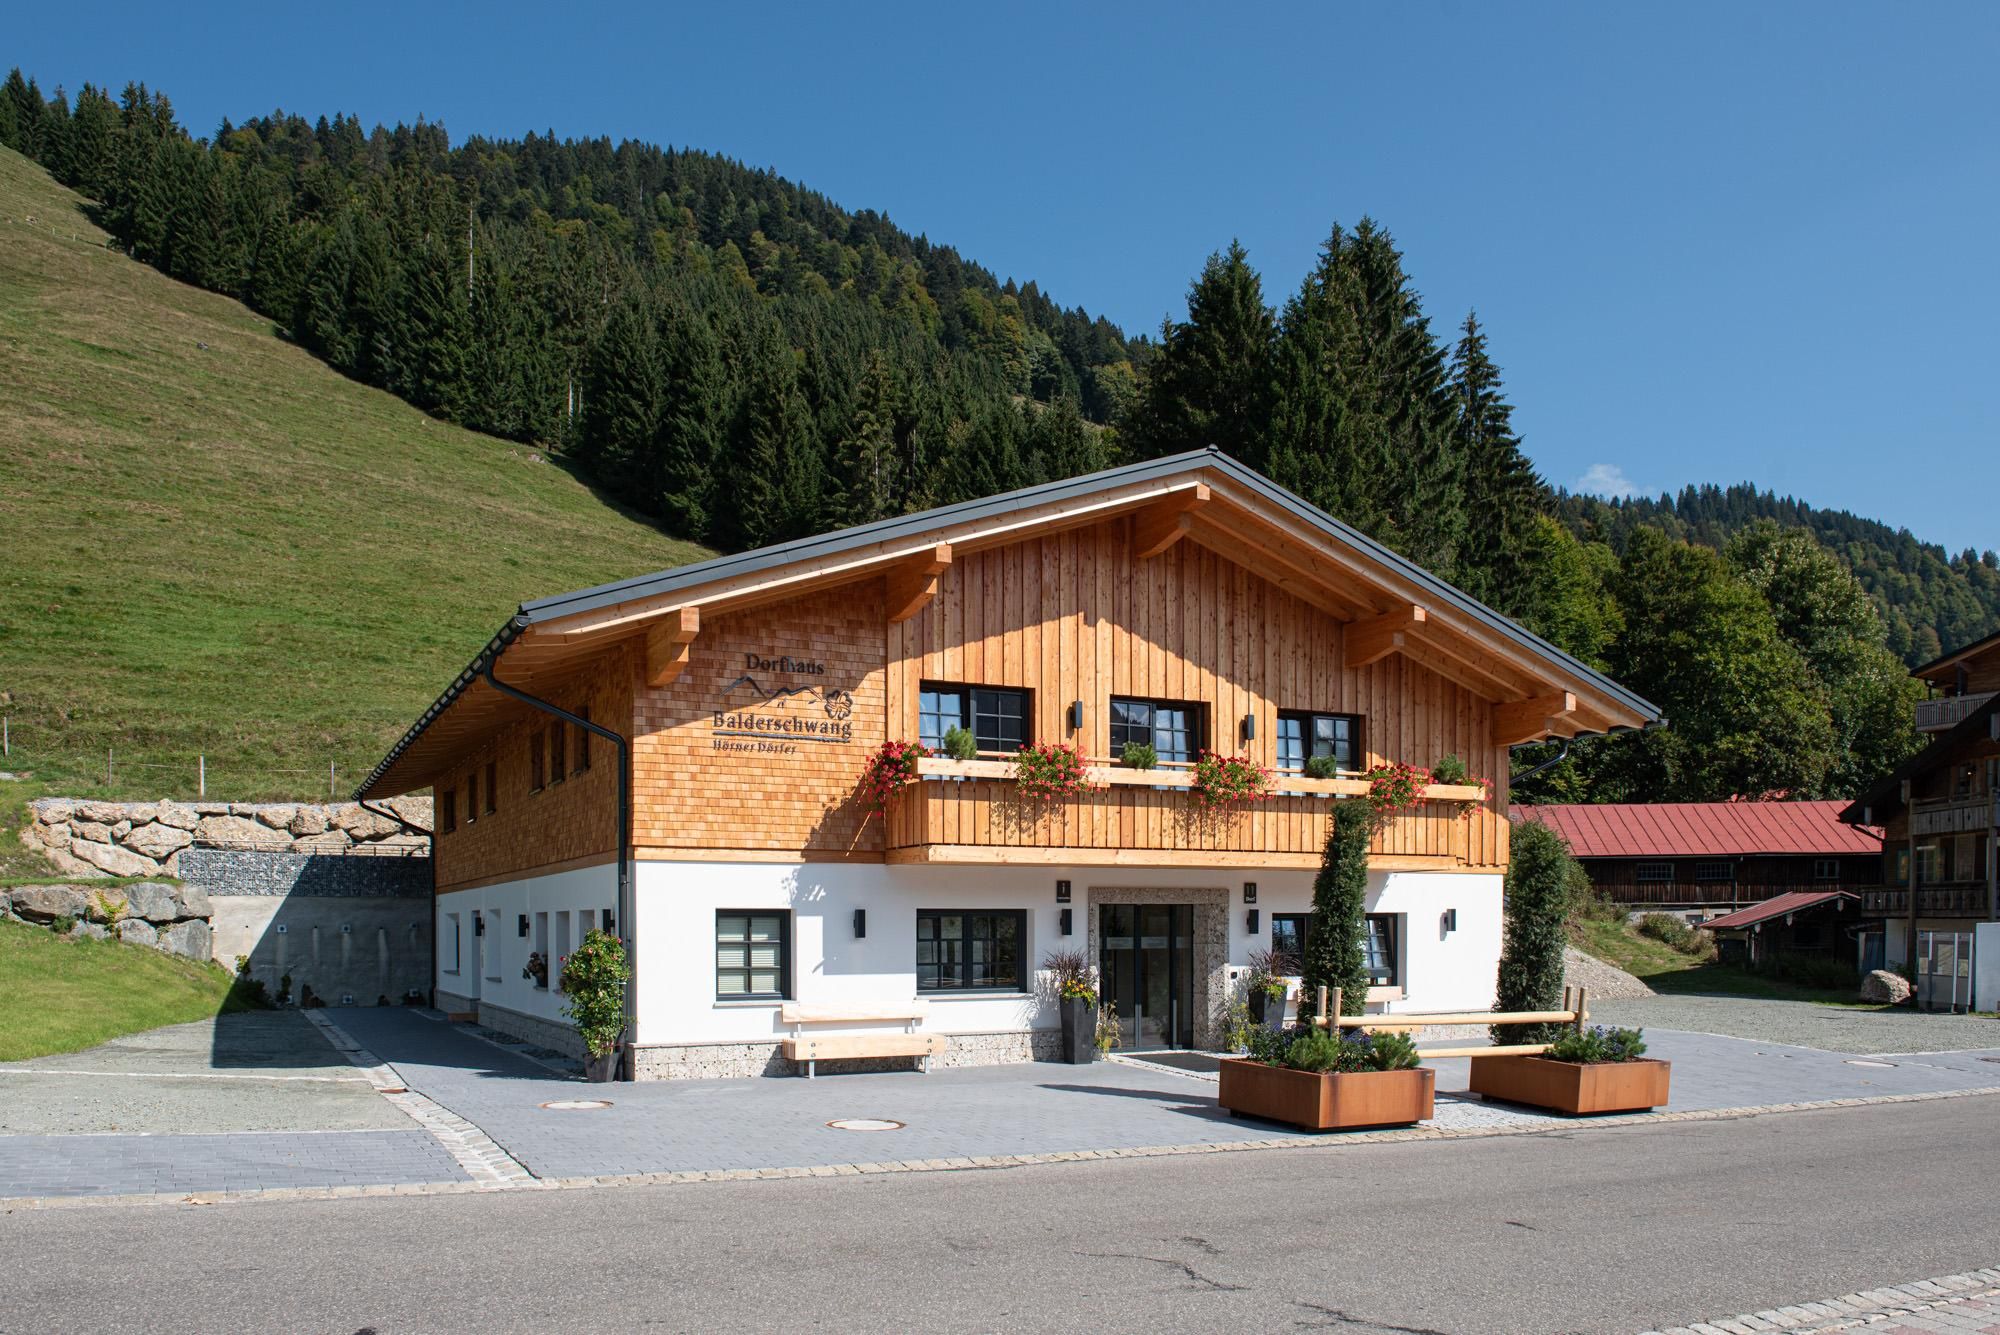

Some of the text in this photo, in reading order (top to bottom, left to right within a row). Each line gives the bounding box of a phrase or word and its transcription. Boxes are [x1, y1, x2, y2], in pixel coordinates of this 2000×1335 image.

[745, 652, 825, 674] Dorfhaus
[713, 710, 852, 739] Balderschwang
[713, 739, 755, 752] Hörner
